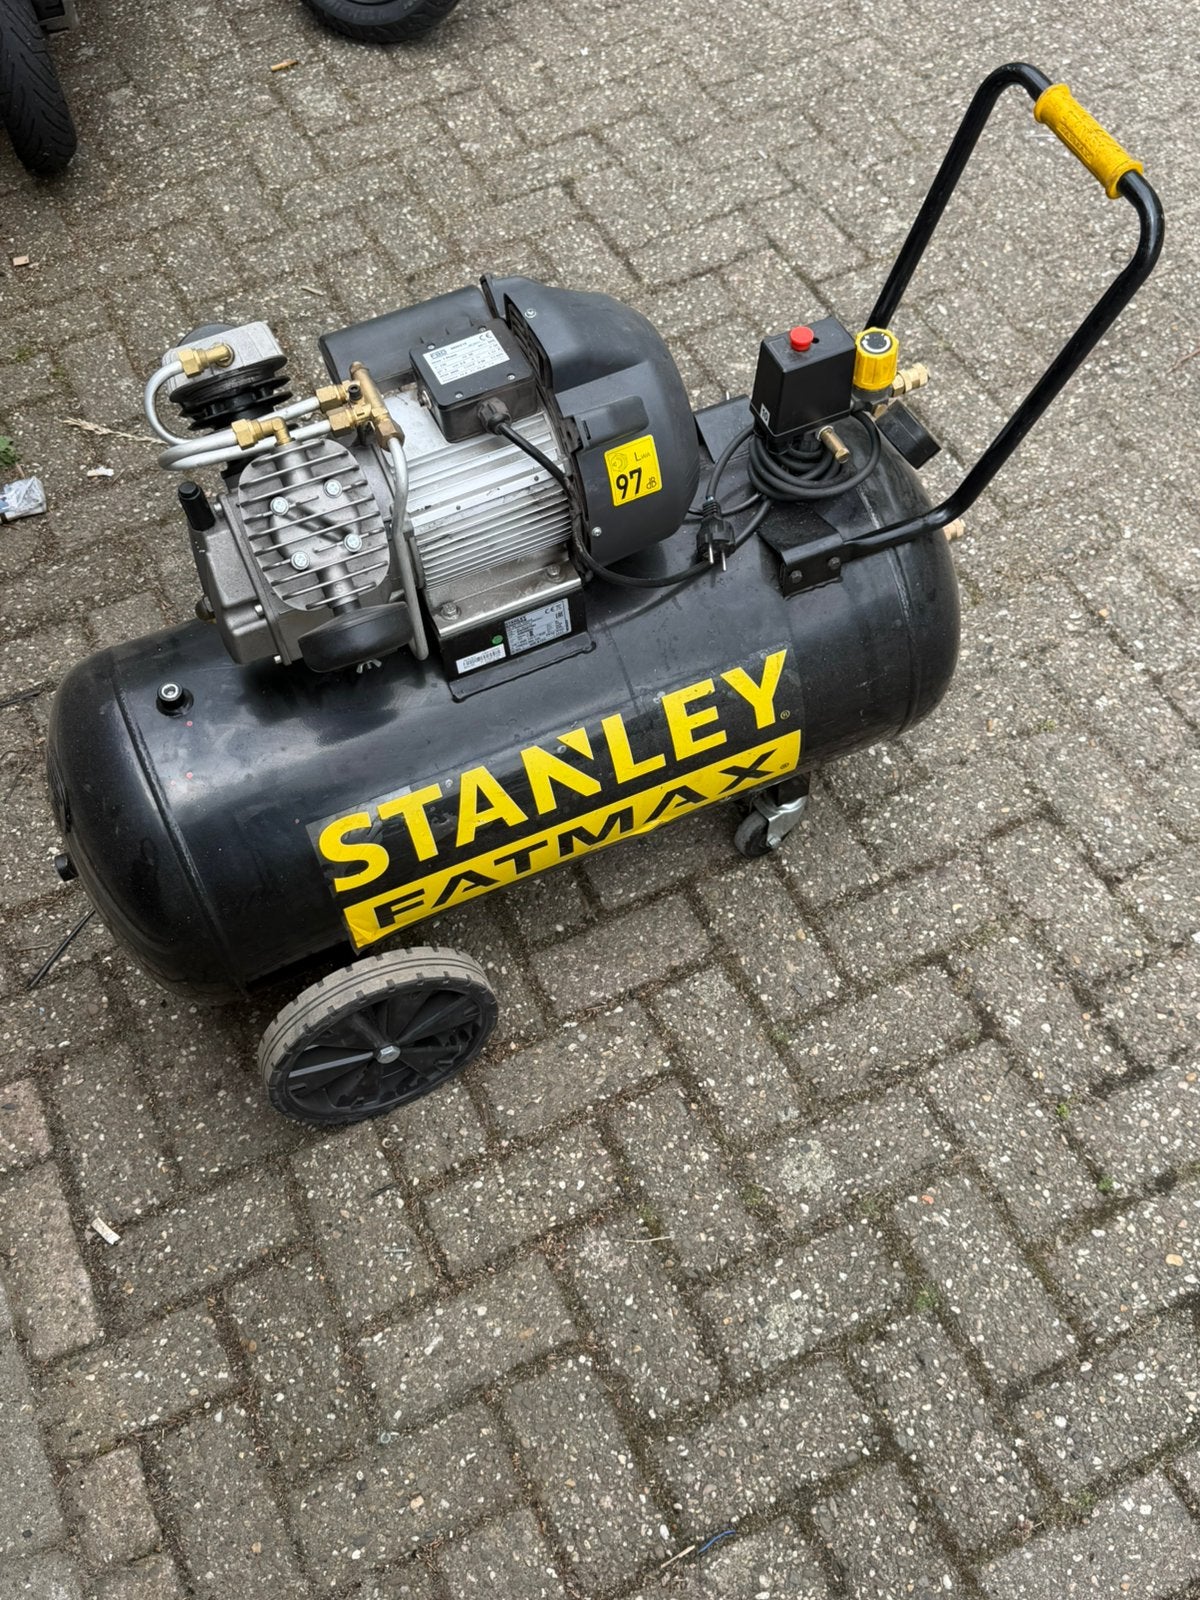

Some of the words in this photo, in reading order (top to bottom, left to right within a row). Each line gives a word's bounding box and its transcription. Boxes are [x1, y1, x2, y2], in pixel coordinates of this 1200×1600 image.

[616, 467, 642, 500] 97
[646, 476, 657, 490] dB
[318, 649, 787, 893] STANLEY
[373, 747, 778, 928] FATMAX
